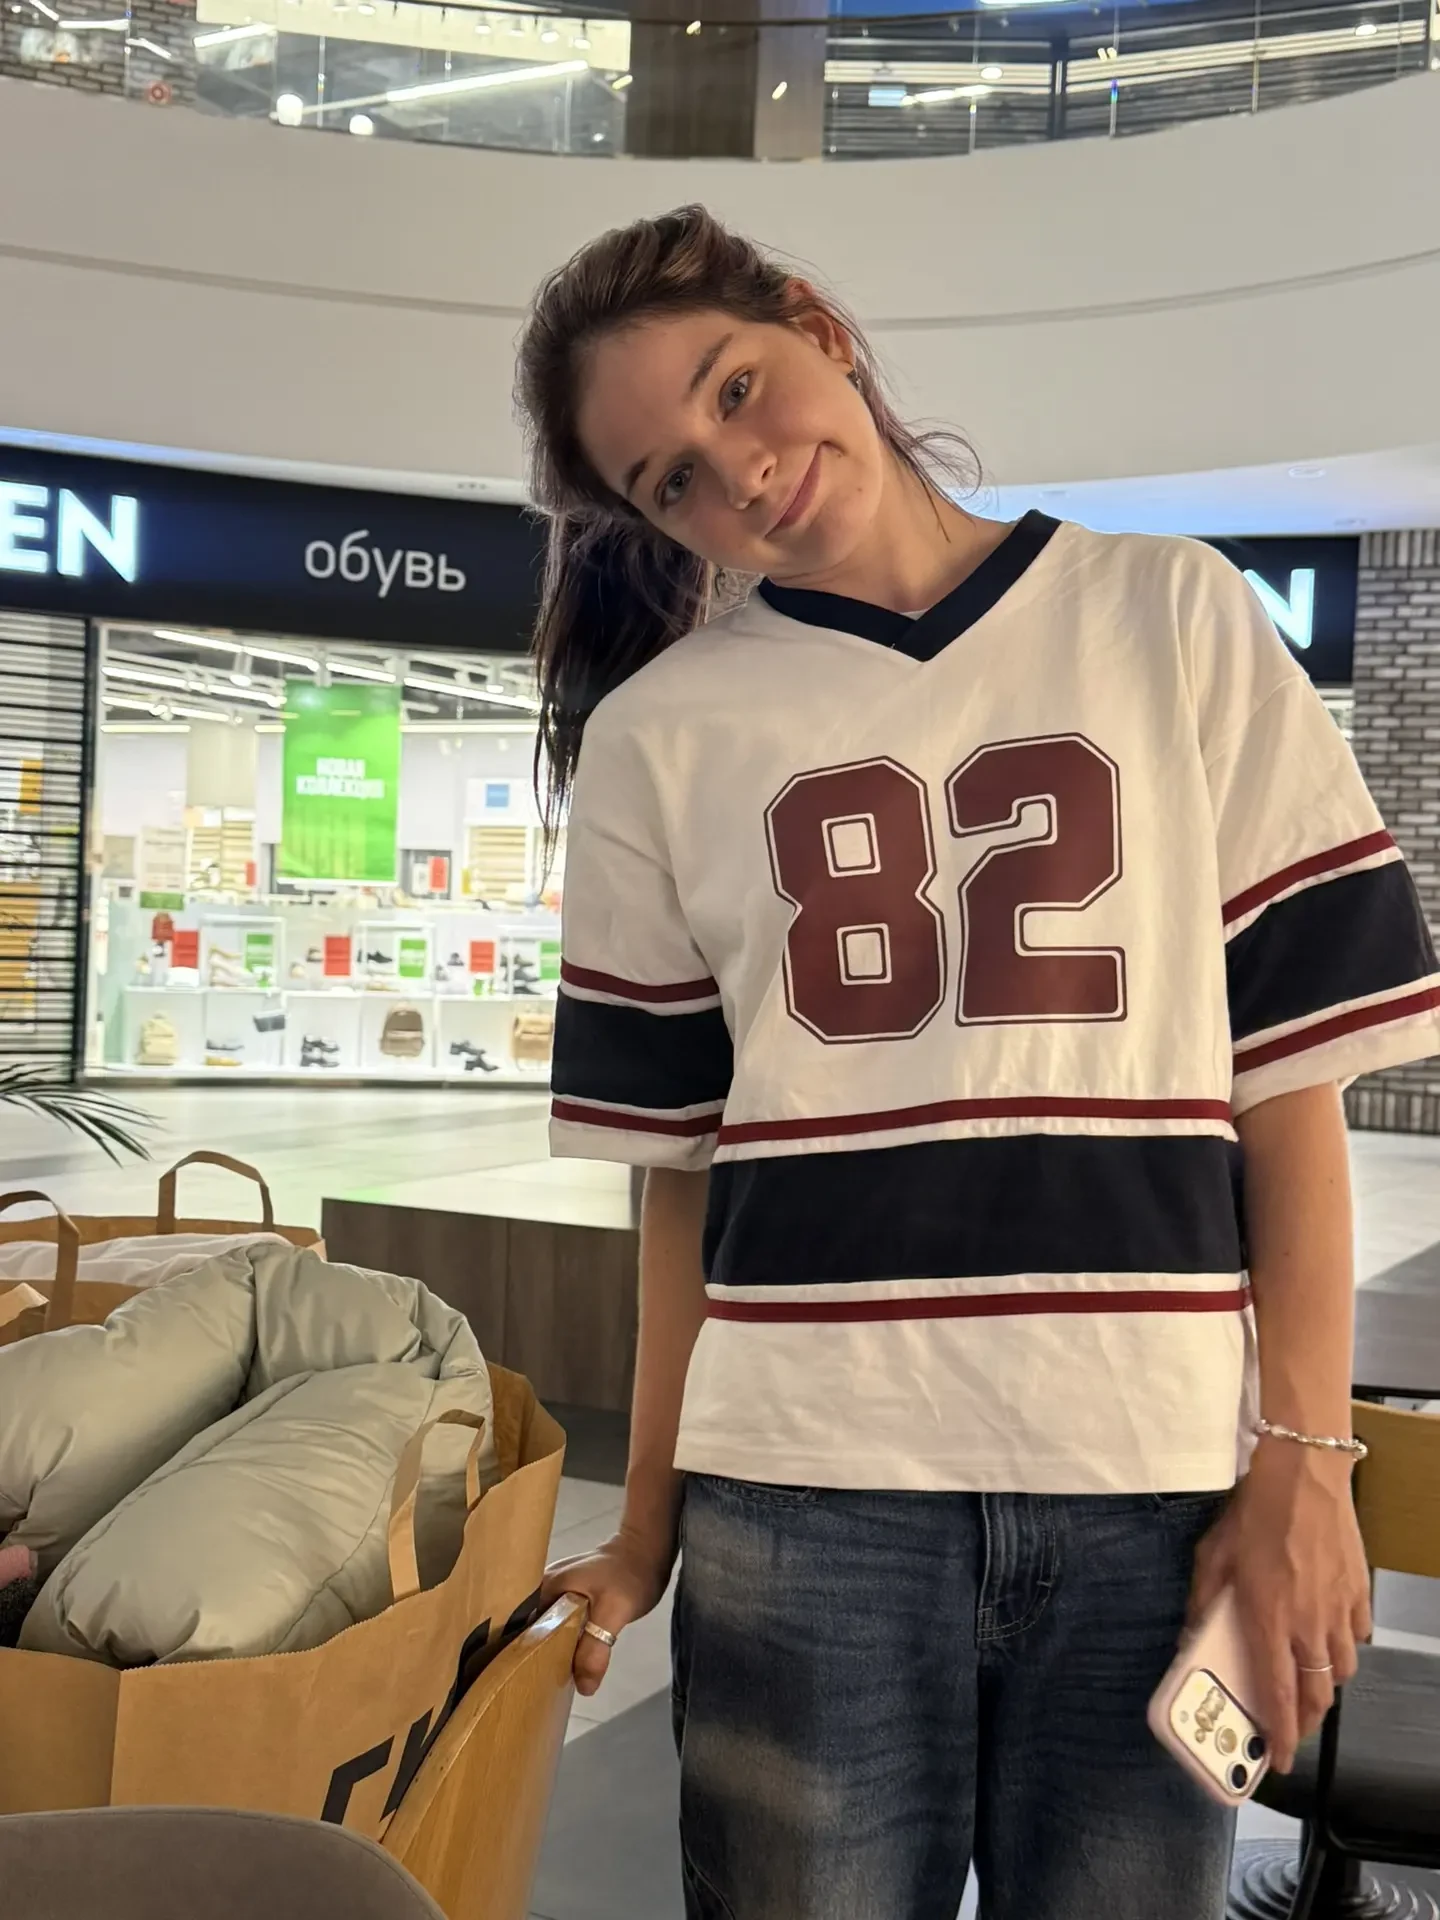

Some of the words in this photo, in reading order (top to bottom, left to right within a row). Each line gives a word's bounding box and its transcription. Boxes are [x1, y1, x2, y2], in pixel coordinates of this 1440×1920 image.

[0, 480, 138, 583] EN
[305, 529, 467, 598] обувь
[764, 732, 1127, 1045] 82
